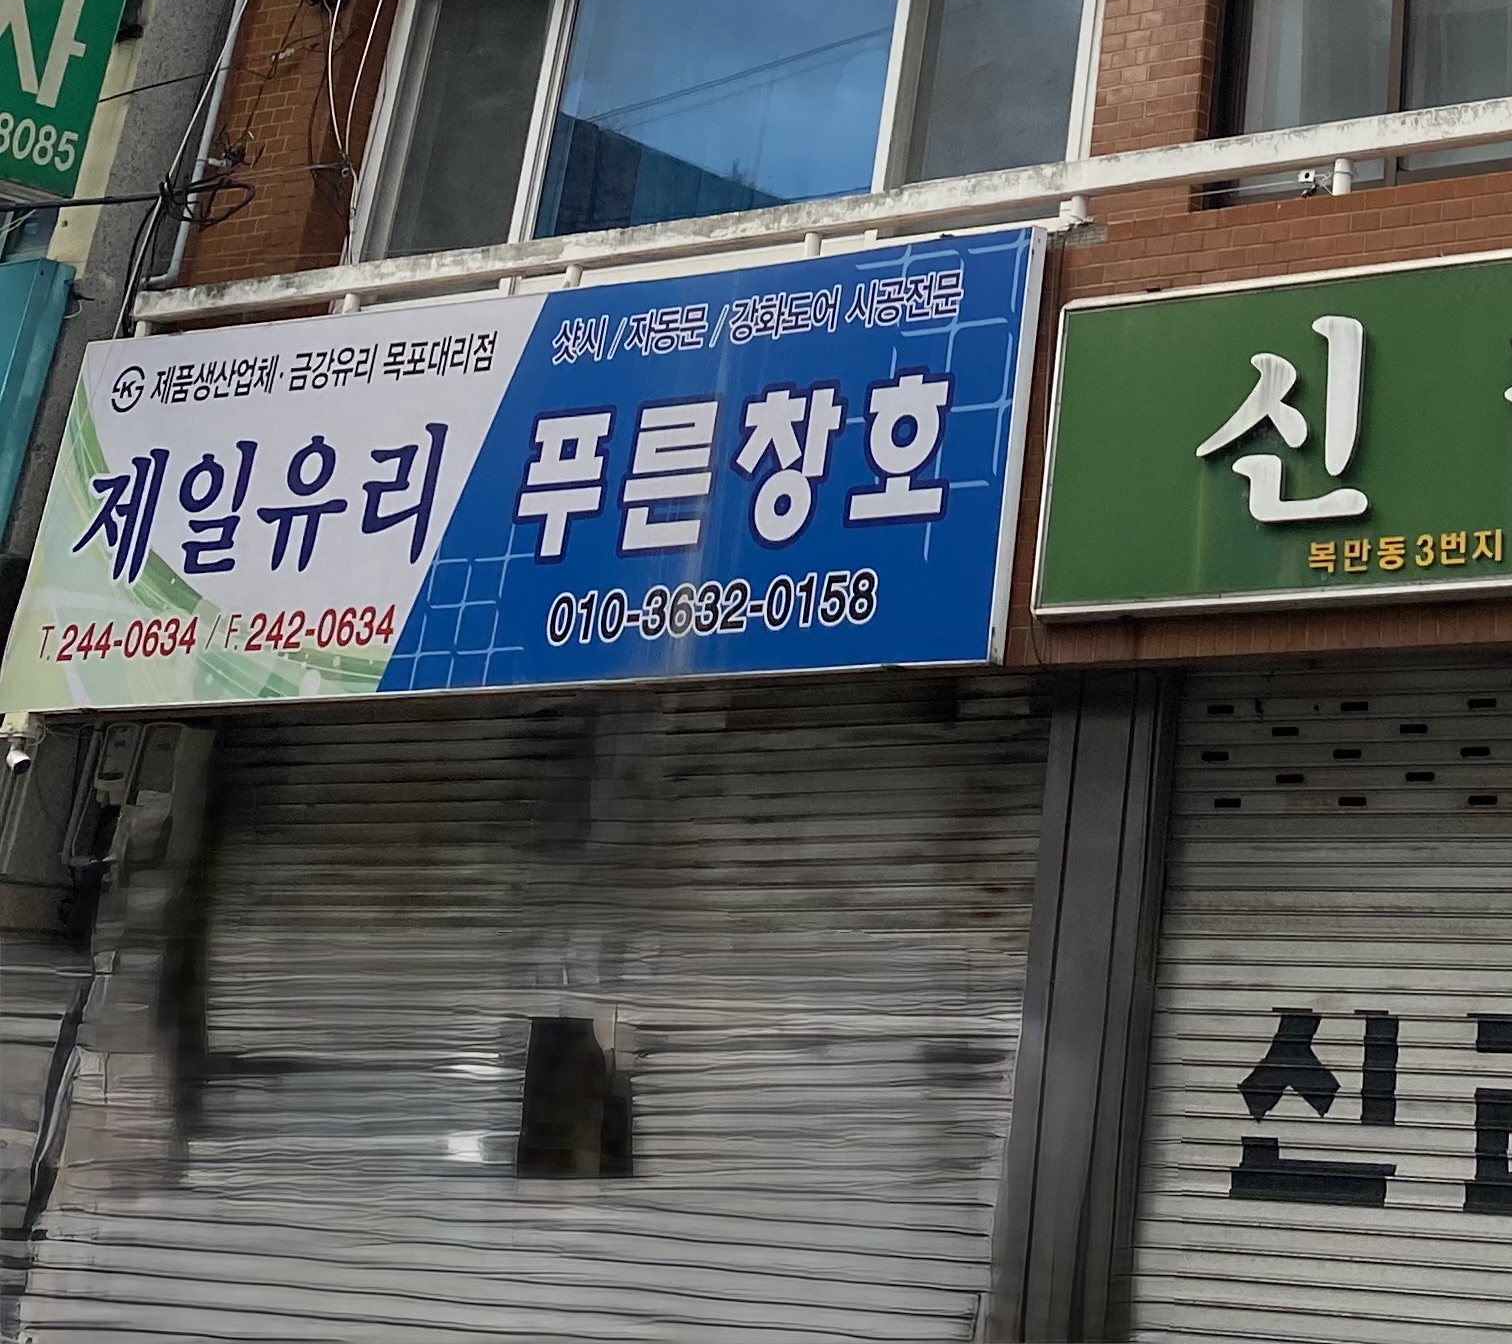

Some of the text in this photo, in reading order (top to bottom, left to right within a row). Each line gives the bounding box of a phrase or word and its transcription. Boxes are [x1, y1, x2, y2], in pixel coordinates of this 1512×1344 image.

[845, 269, 964, 329] 시공전문
[382, 330, 498, 381] 목포대리점
[71, 422, 450, 585] 제일유리
[515, 370, 953, 560] 푸른창호
[546, 568, 878, 647] 010-3632-0158
